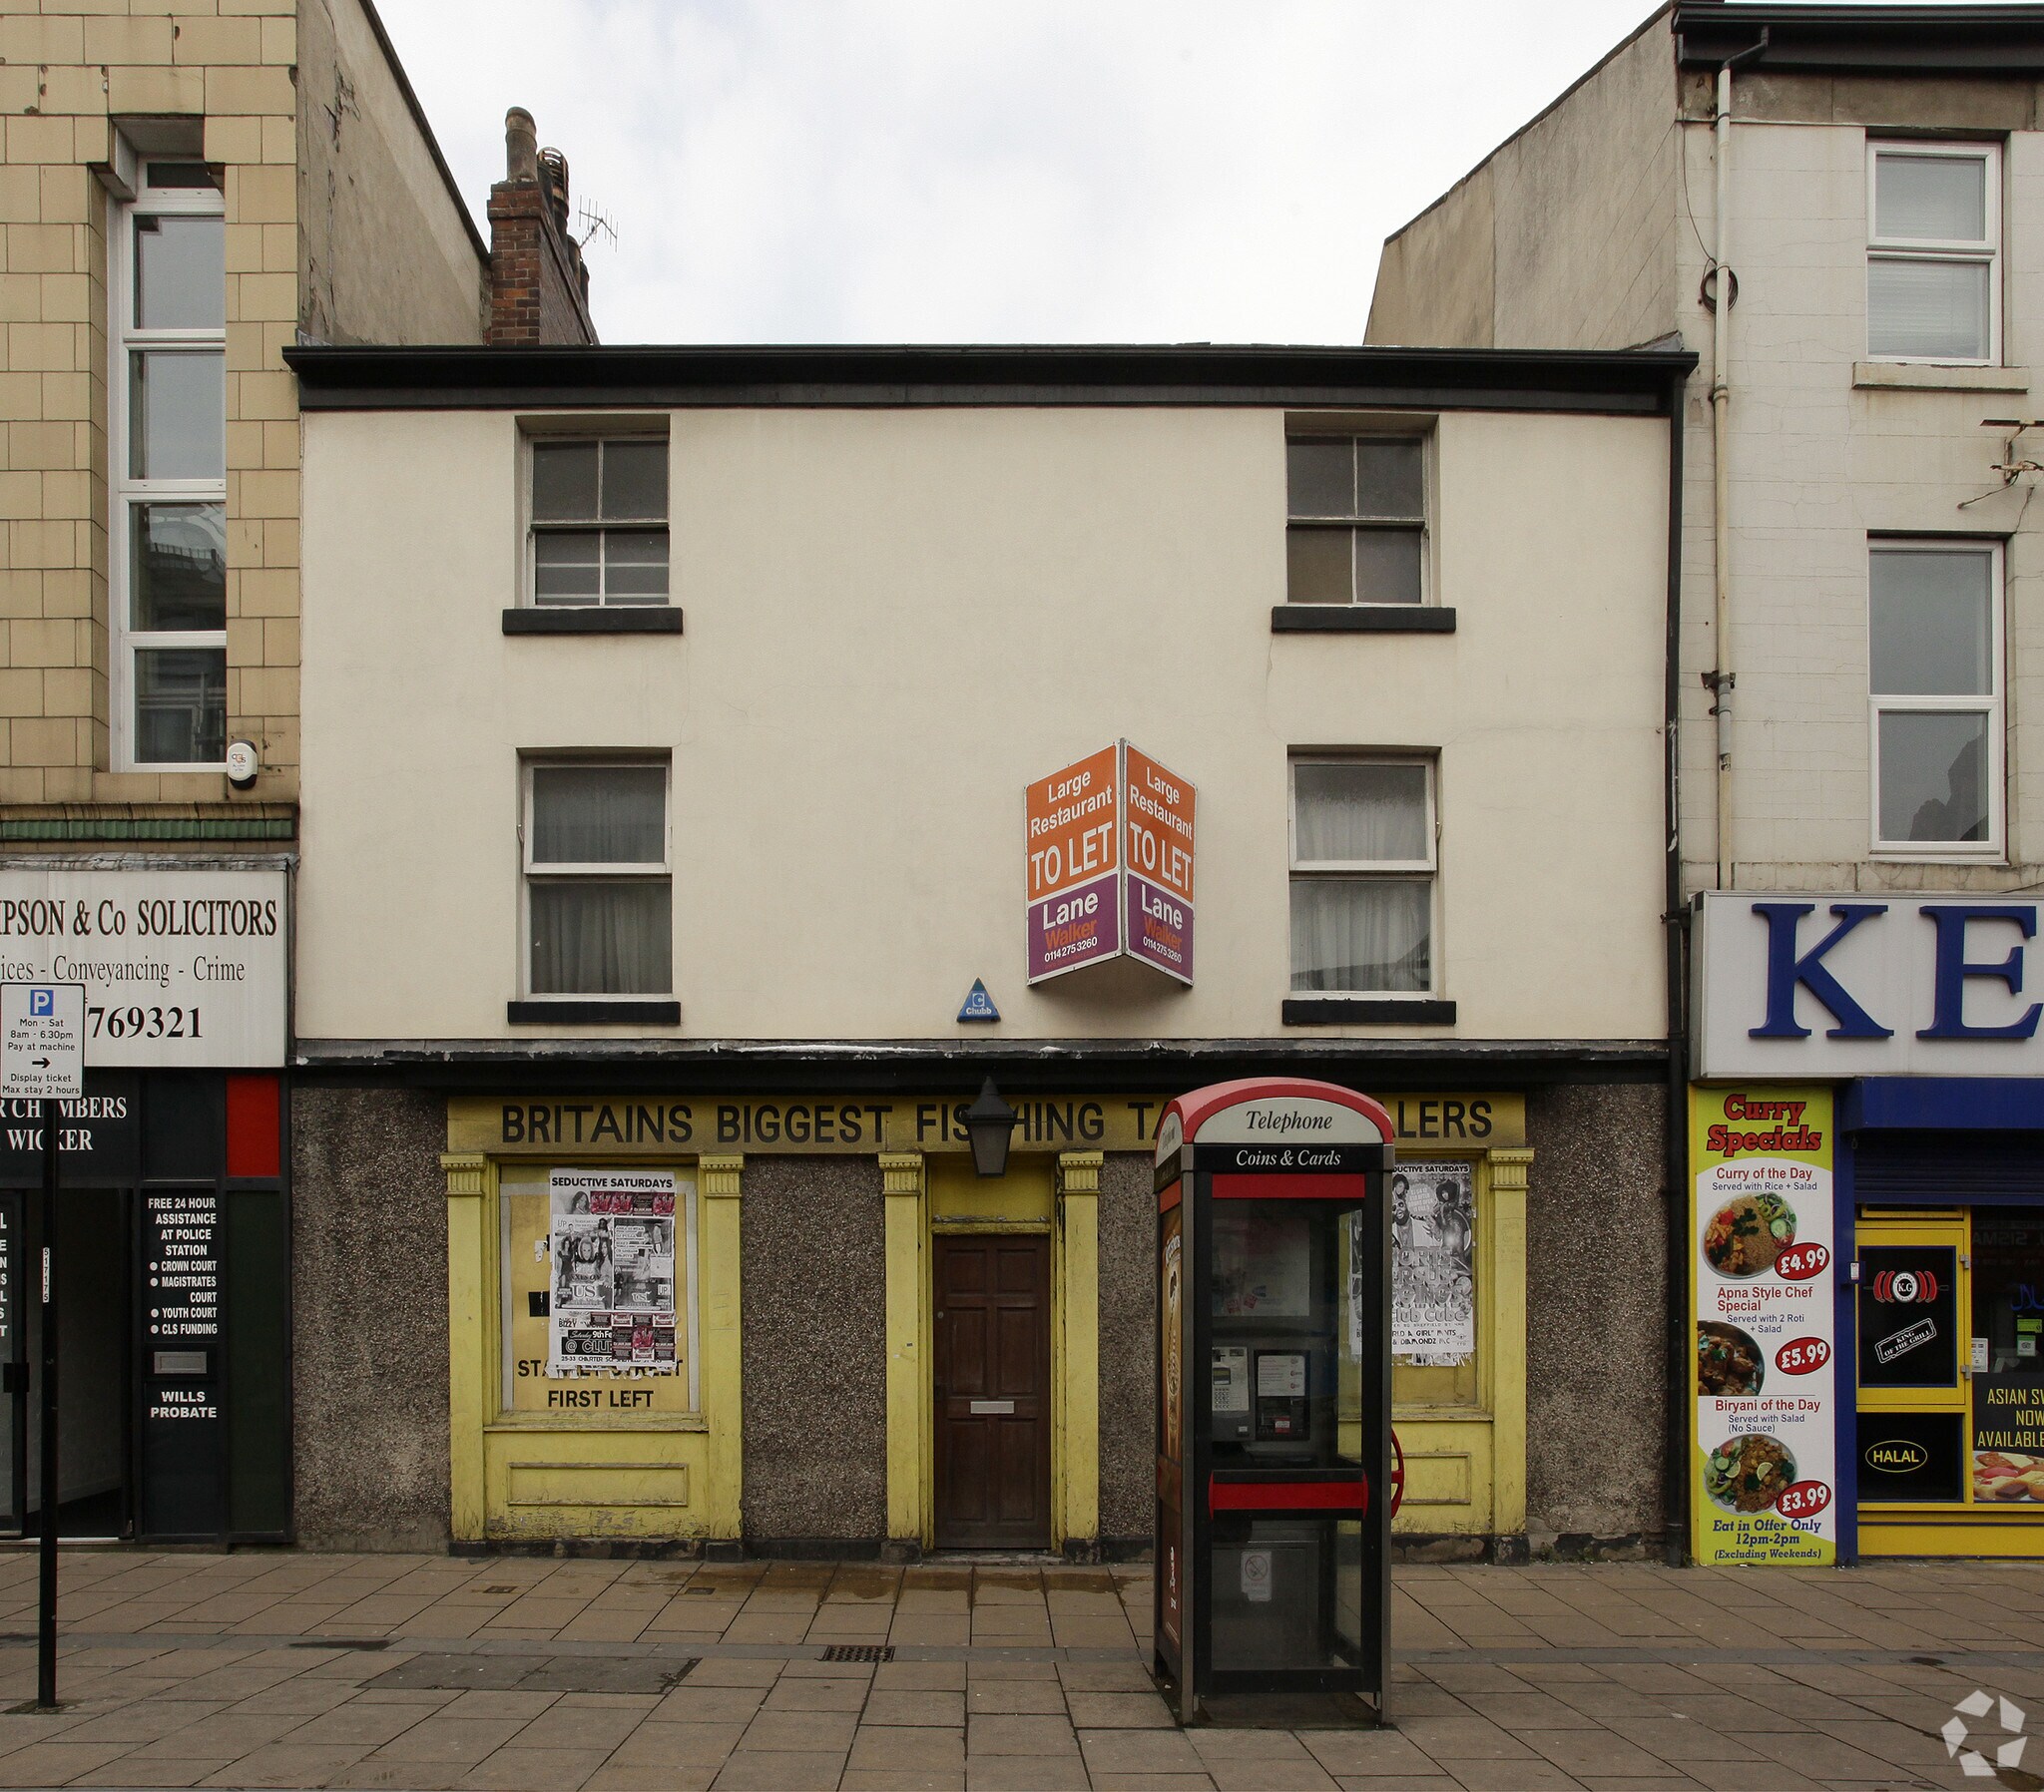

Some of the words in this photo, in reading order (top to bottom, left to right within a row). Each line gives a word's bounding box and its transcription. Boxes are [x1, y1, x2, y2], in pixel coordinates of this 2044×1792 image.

[1048, 769, 1091, 804] Large
[1147, 766, 1180, 805] Large
[1030, 783, 1113, 839] Restaurant
[1130, 783, 1193, 841] Restaurant
[1031, 844, 1062, 891] TO
[1069, 820, 1113, 877] LET
[1130, 821, 1157, 871] TO
[1162, 838, 1193, 892] LET
[1043, 892, 1099, 930] Lane
[1142, 884, 1183, 930] Lane
[72, 899, 92, 936] &
[98, 899, 127, 936] Co
[137, 899, 277, 936] SOLICITORS
[1044, 918, 1098, 949] Walker
[1144, 916, 1183, 949] Walker
[0, 955, 34, 981] ices
[54, 955, 170, 988] Conveyancing
[194, 955, 246, 981] Crime
[1748, 903, 2044, 1039] KE
[34, 992, 50, 1014] P
[965, 1006, 992, 1015] Chubb
[20, 1018, 38, 1028] Mon
[49, 1018, 64, 1028] Sat
[87, 1006, 204, 1039] 769321
[10, 1030, 31, 1040] 8am
[40, 1030, 74, 1042] 6.30pm
[8, 1042, 24, 1053] Pay
[27, 1043, 37, 1052] at
[40, 1042, 76, 1052] machine
[10, 1074, 43, 1086] Display
[46, 1074, 72, 1084] ticket
[2, 1086, 21, 1095] Max
[24, 1086, 44, 1097] stay
[47, 1086, 53, 1095] 2
[56, 1086, 80, 1095] hours
[11, 1097, 128, 1119] CHMBERS
[1724, 1094, 1806, 1126] Curry
[502, 1104, 694, 1143] BRITAINS
[717, 1104, 892, 1143] BIGGEST
[1393, 1100, 1492, 1139] LERS
[1246, 1111, 1333, 1132] Telephone
[1707, 1124, 1822, 1157] Specials
[1236, 1149, 1277, 1167] Coins
[1279, 1150, 1293, 1167] &
[1297, 1149, 1341, 1168] Cards
[1424, 1164, 1469, 1173] SATURDAYS
[1716, 1167, 1750, 1181] Curry
[1753, 1167, 1765, 1179] of
[1767, 1167, 1787, 1179] the
[1789, 1167, 1813, 1181] Day
[551, 1177, 608, 1188] SEDUCTIVE
[610, 1177, 674, 1189] SATURDAYS
[1712, 1181, 1743, 1191] Served
[1744, 1181, 1763, 1191] with
[1765, 1181, 1785, 1191] Rice
[1793, 1181, 1817, 1191] Salad
[148, 1197, 173, 1209] FREE
[175, 1197, 188, 1209] 24
[189, 1197, 217, 1209] HOUR
[156, 1213, 217, 1225] ASSISTANCE
[161, 1229, 175, 1241] AT
[176, 1229, 212, 1241] POLICE
[165, 1244, 208, 1256] STATION
[161, 1260, 190, 1272] CROWN
[191, 1260, 218, 1272] COURT
[1780, 1246, 1827, 1275] £4.99
[162, 1276, 217, 1288] MAGISTRATES
[190, 1291, 218, 1303] COURT
[1717, 1287, 1749, 1300] Apna
[1752, 1286, 1783, 1300] Style
[1785, 1286, 1813, 1298] Chef
[162, 1307, 189, 1319] YOUTH
[191, 1307, 218, 1319] COURT
[1717, 1299, 1762, 1313] Special
[1424, 1308, 1466, 1323] Cube
[1727, 1313, 1758, 1323] Served
[1759, 1313, 1778, 1323] with
[1780, 1314, 1786, 1323] 2
[1788, 1314, 1804, 1323] Roti
[162, 1322, 179, 1335] CLS
[180, 1322, 218, 1336] FUNDING
[1758, 1324, 1783, 1334] Salad
[1884, 1347, 1894, 1357] OF
[1894, 1339, 1910, 1352] THE
[1908, 1329, 1931, 1344] GRILL
[1895, 1331, 1915, 1344] KING
[1781, 1341, 1828, 1370] £5.99
[161, 1391, 206, 1403] WILLS
[548, 1390, 603, 1408] FIRST
[610, 1390, 655, 1408] LEFT
[1987, 1388, 2027, 1405] ASIAN
[151, 1407, 218, 1419] PROBATE
[1715, 1399, 1758, 1414] Biryani
[1761, 1399, 1774, 1411] of
[1776, 1399, 1795, 1411] the
[1797, 1399, 1821, 1413] Day
[1728, 1414, 1759, 1424] Served
[1761, 1414, 1779, 1424] with
[1781, 1414, 1805, 1423] Salad
[2016, 1410, 2044, 1427] NOW
[1728, 1423, 1744, 1435] (No
[1746, 1423, 1776, 1435] Sauce)
[1977, 1431, 2044, 1448] AVAILABLE
[1872, 1450, 1919, 1464] HALAL
[1782, 1485, 1828, 1513] £3.99
[1713, 1520, 1736, 1532] Eat
[1738, 1520, 1751, 1532] in
[1754, 1519, 1788, 1532] Offer
[1790, 1519, 1822, 1534] Only
[1736, 1533, 1800, 1548] 12pm-2pm
[1714, 1550, 1767, 1561] (Excluding
[1769, 1549, 1822, 1560] Weekends)
